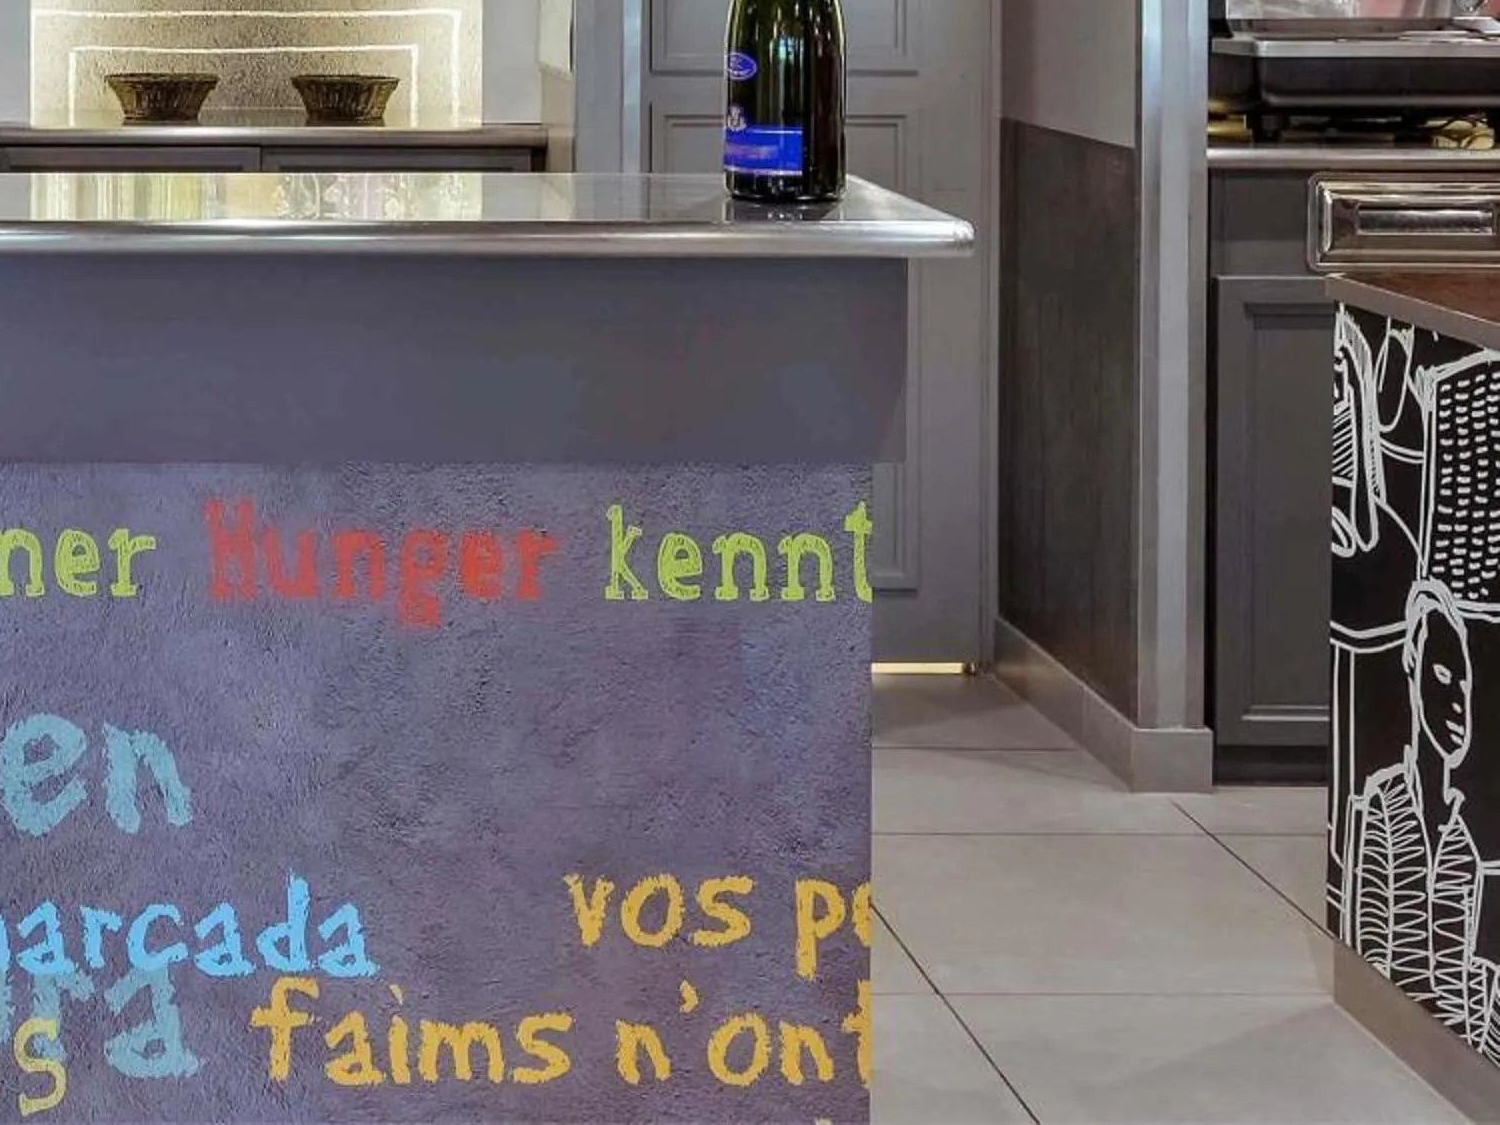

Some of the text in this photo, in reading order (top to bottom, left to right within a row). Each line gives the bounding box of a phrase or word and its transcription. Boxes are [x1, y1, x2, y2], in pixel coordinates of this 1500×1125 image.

[202, 497, 563, 628] Hunger
[604, 501, 873, 603] kennt
[564, 873, 755, 948] vos
[250, 975, 576, 1087] faims
